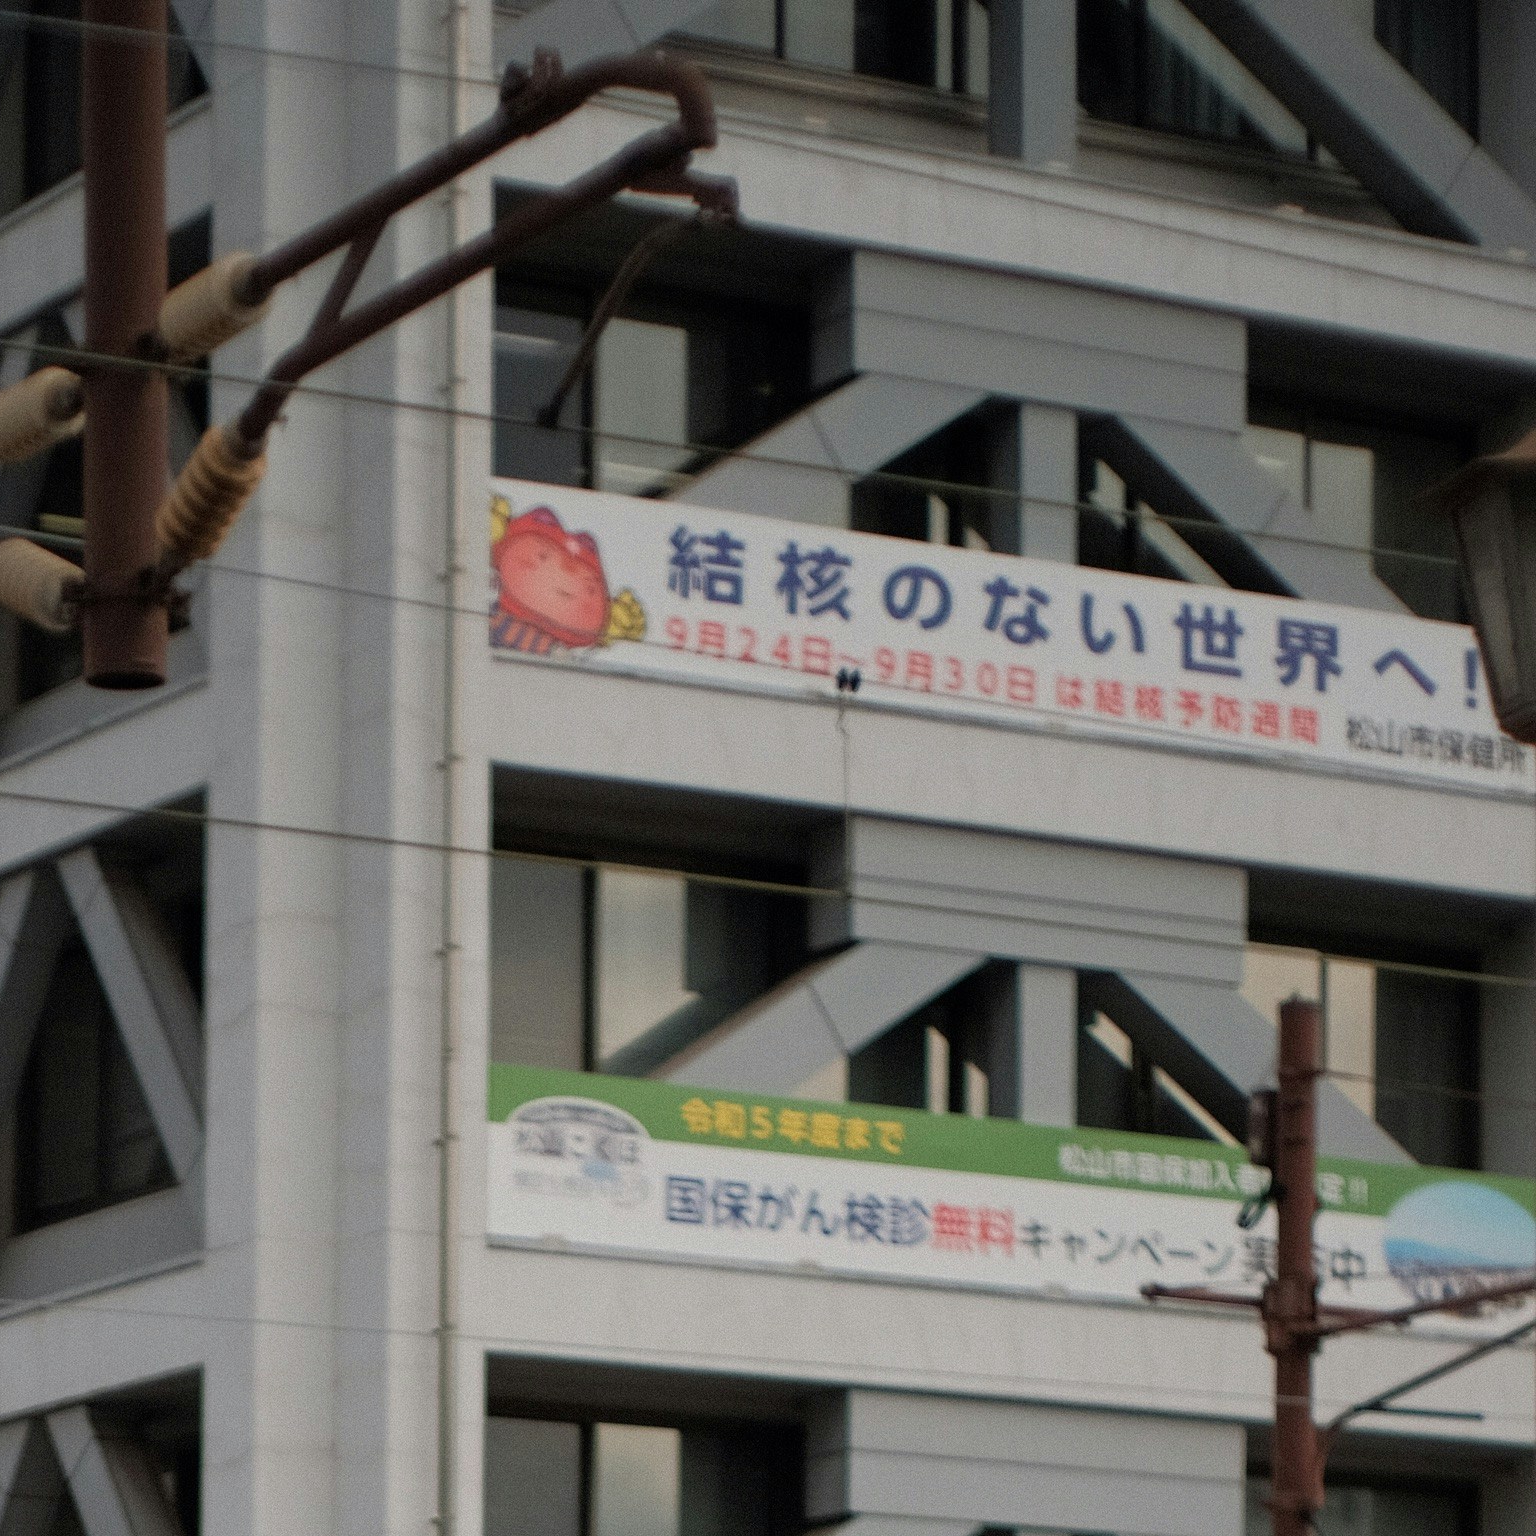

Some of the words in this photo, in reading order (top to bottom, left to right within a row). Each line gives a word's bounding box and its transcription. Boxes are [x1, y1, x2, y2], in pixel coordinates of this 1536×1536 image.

[681, 1097, 904, 1154] 令和5年度まで
[666, 1174, 1366, 1291] 国保がん検診無料キャンペーン実中
